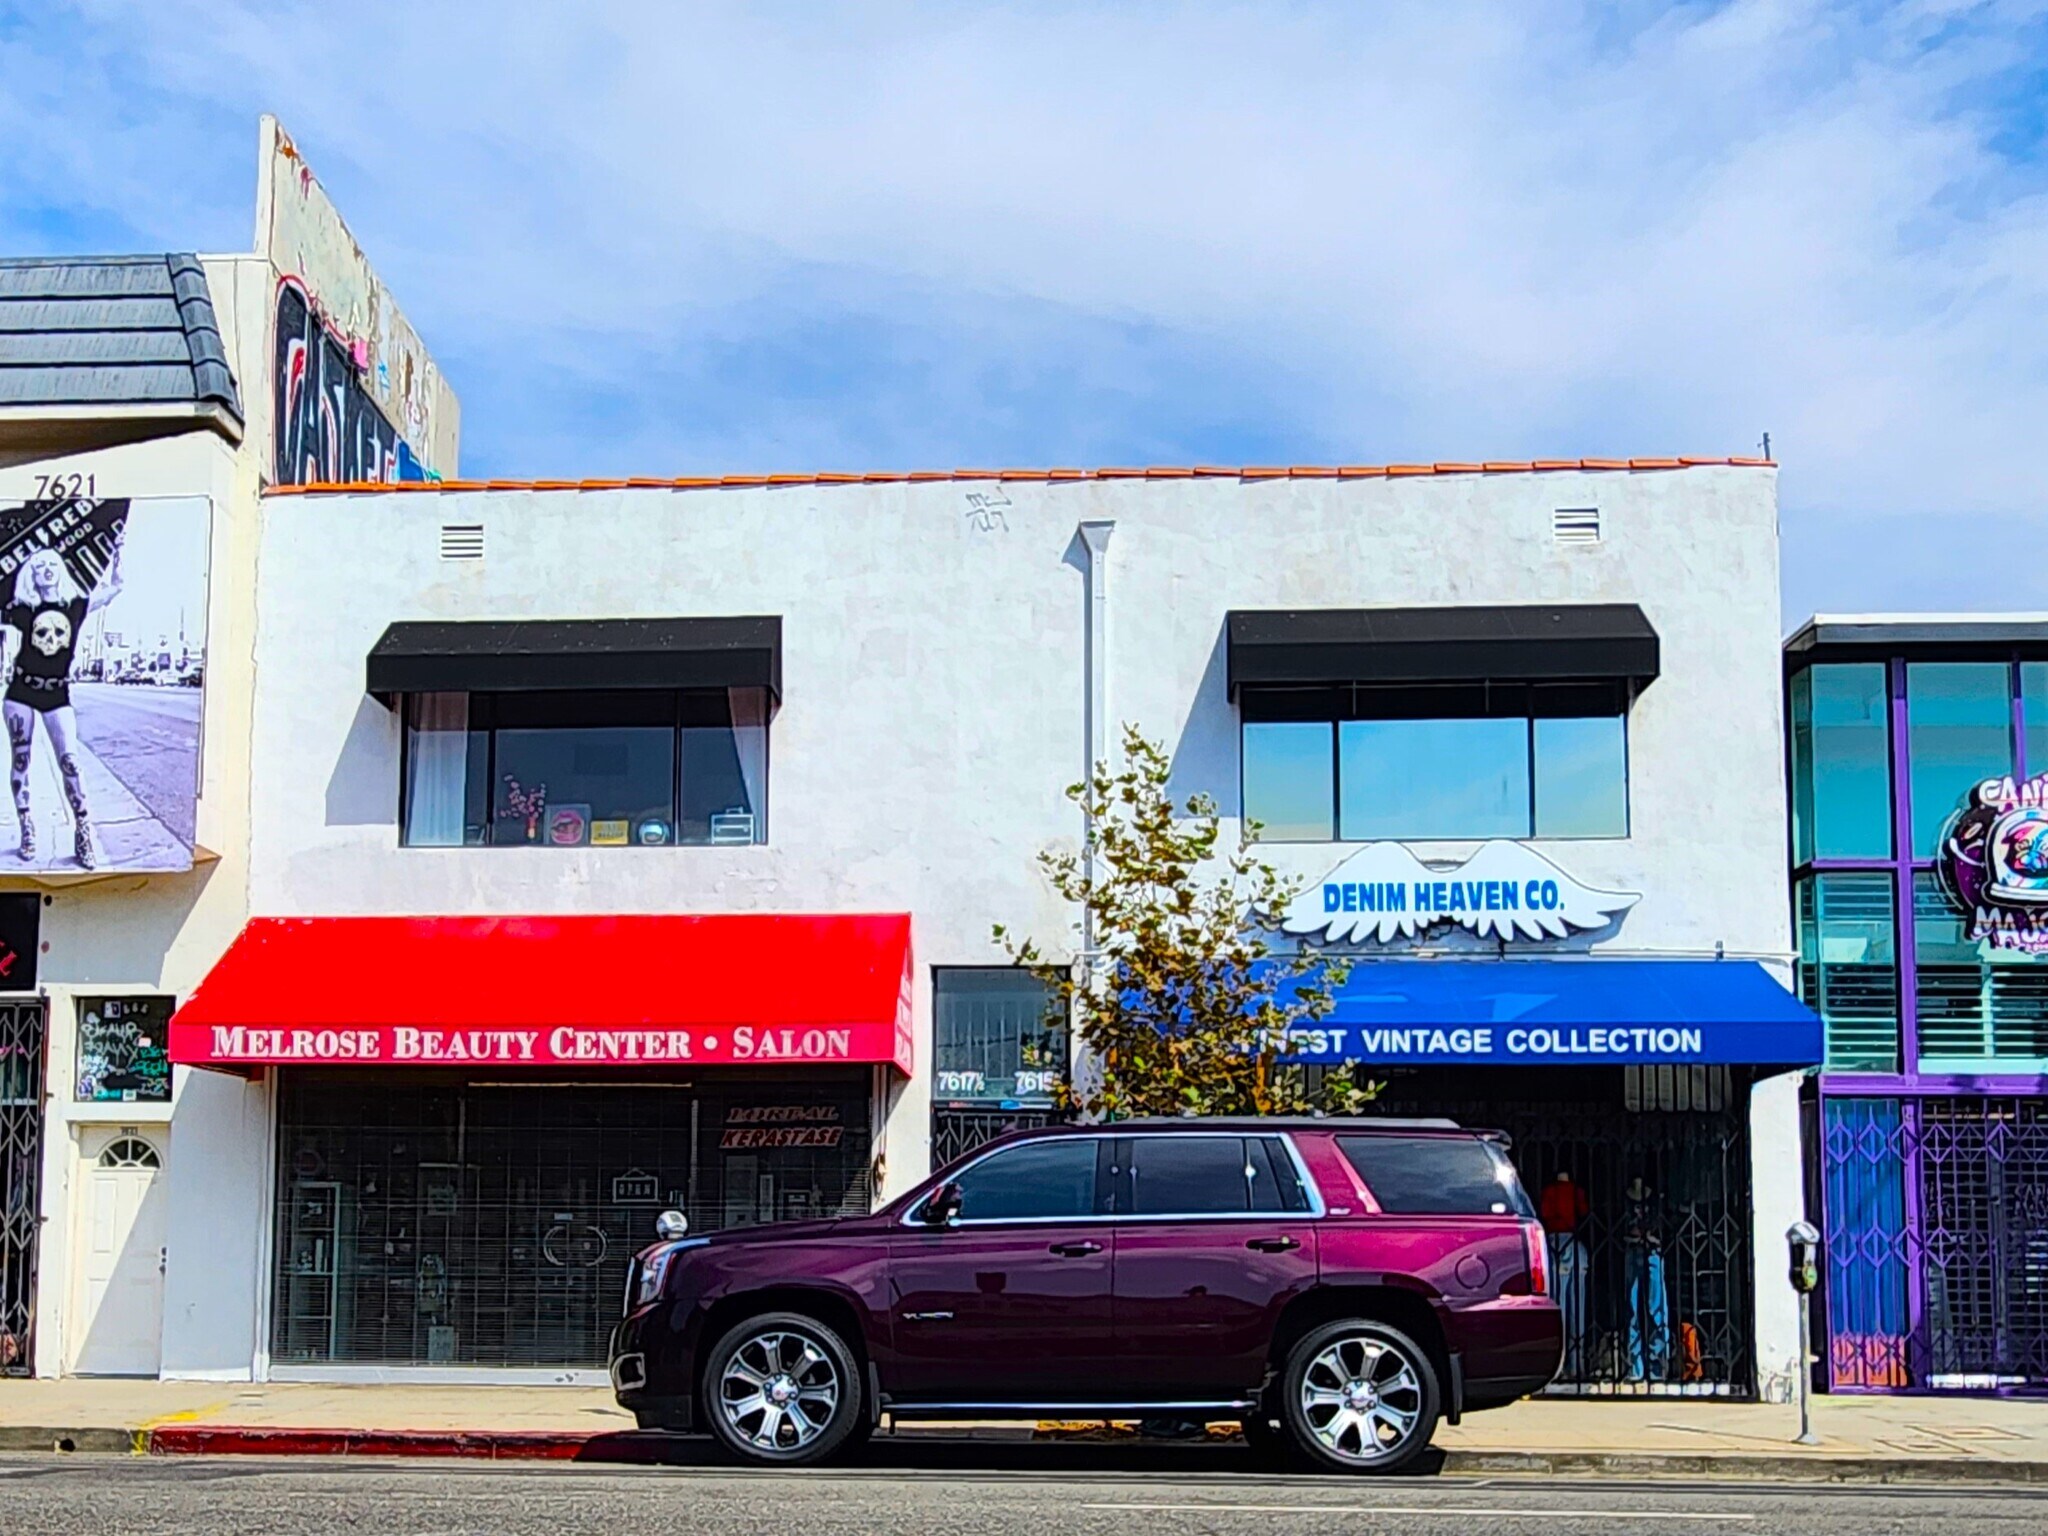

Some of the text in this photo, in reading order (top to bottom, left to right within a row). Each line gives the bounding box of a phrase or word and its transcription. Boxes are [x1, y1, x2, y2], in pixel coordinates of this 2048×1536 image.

[34, 472, 95, 500] 7621
[0, 538, 42, 580] BEL
[1323, 879, 1565, 912] DENIM HEAVEN CO.
[210, 1025, 851, 1060] MELROSE BEAUTY CENTER SALON
[1361, 1029, 1492, 1053] VINTAGE
[1506, 1028, 1702, 1053] COLLECTION
[720, 1126, 844, 1149] KERASTASE
